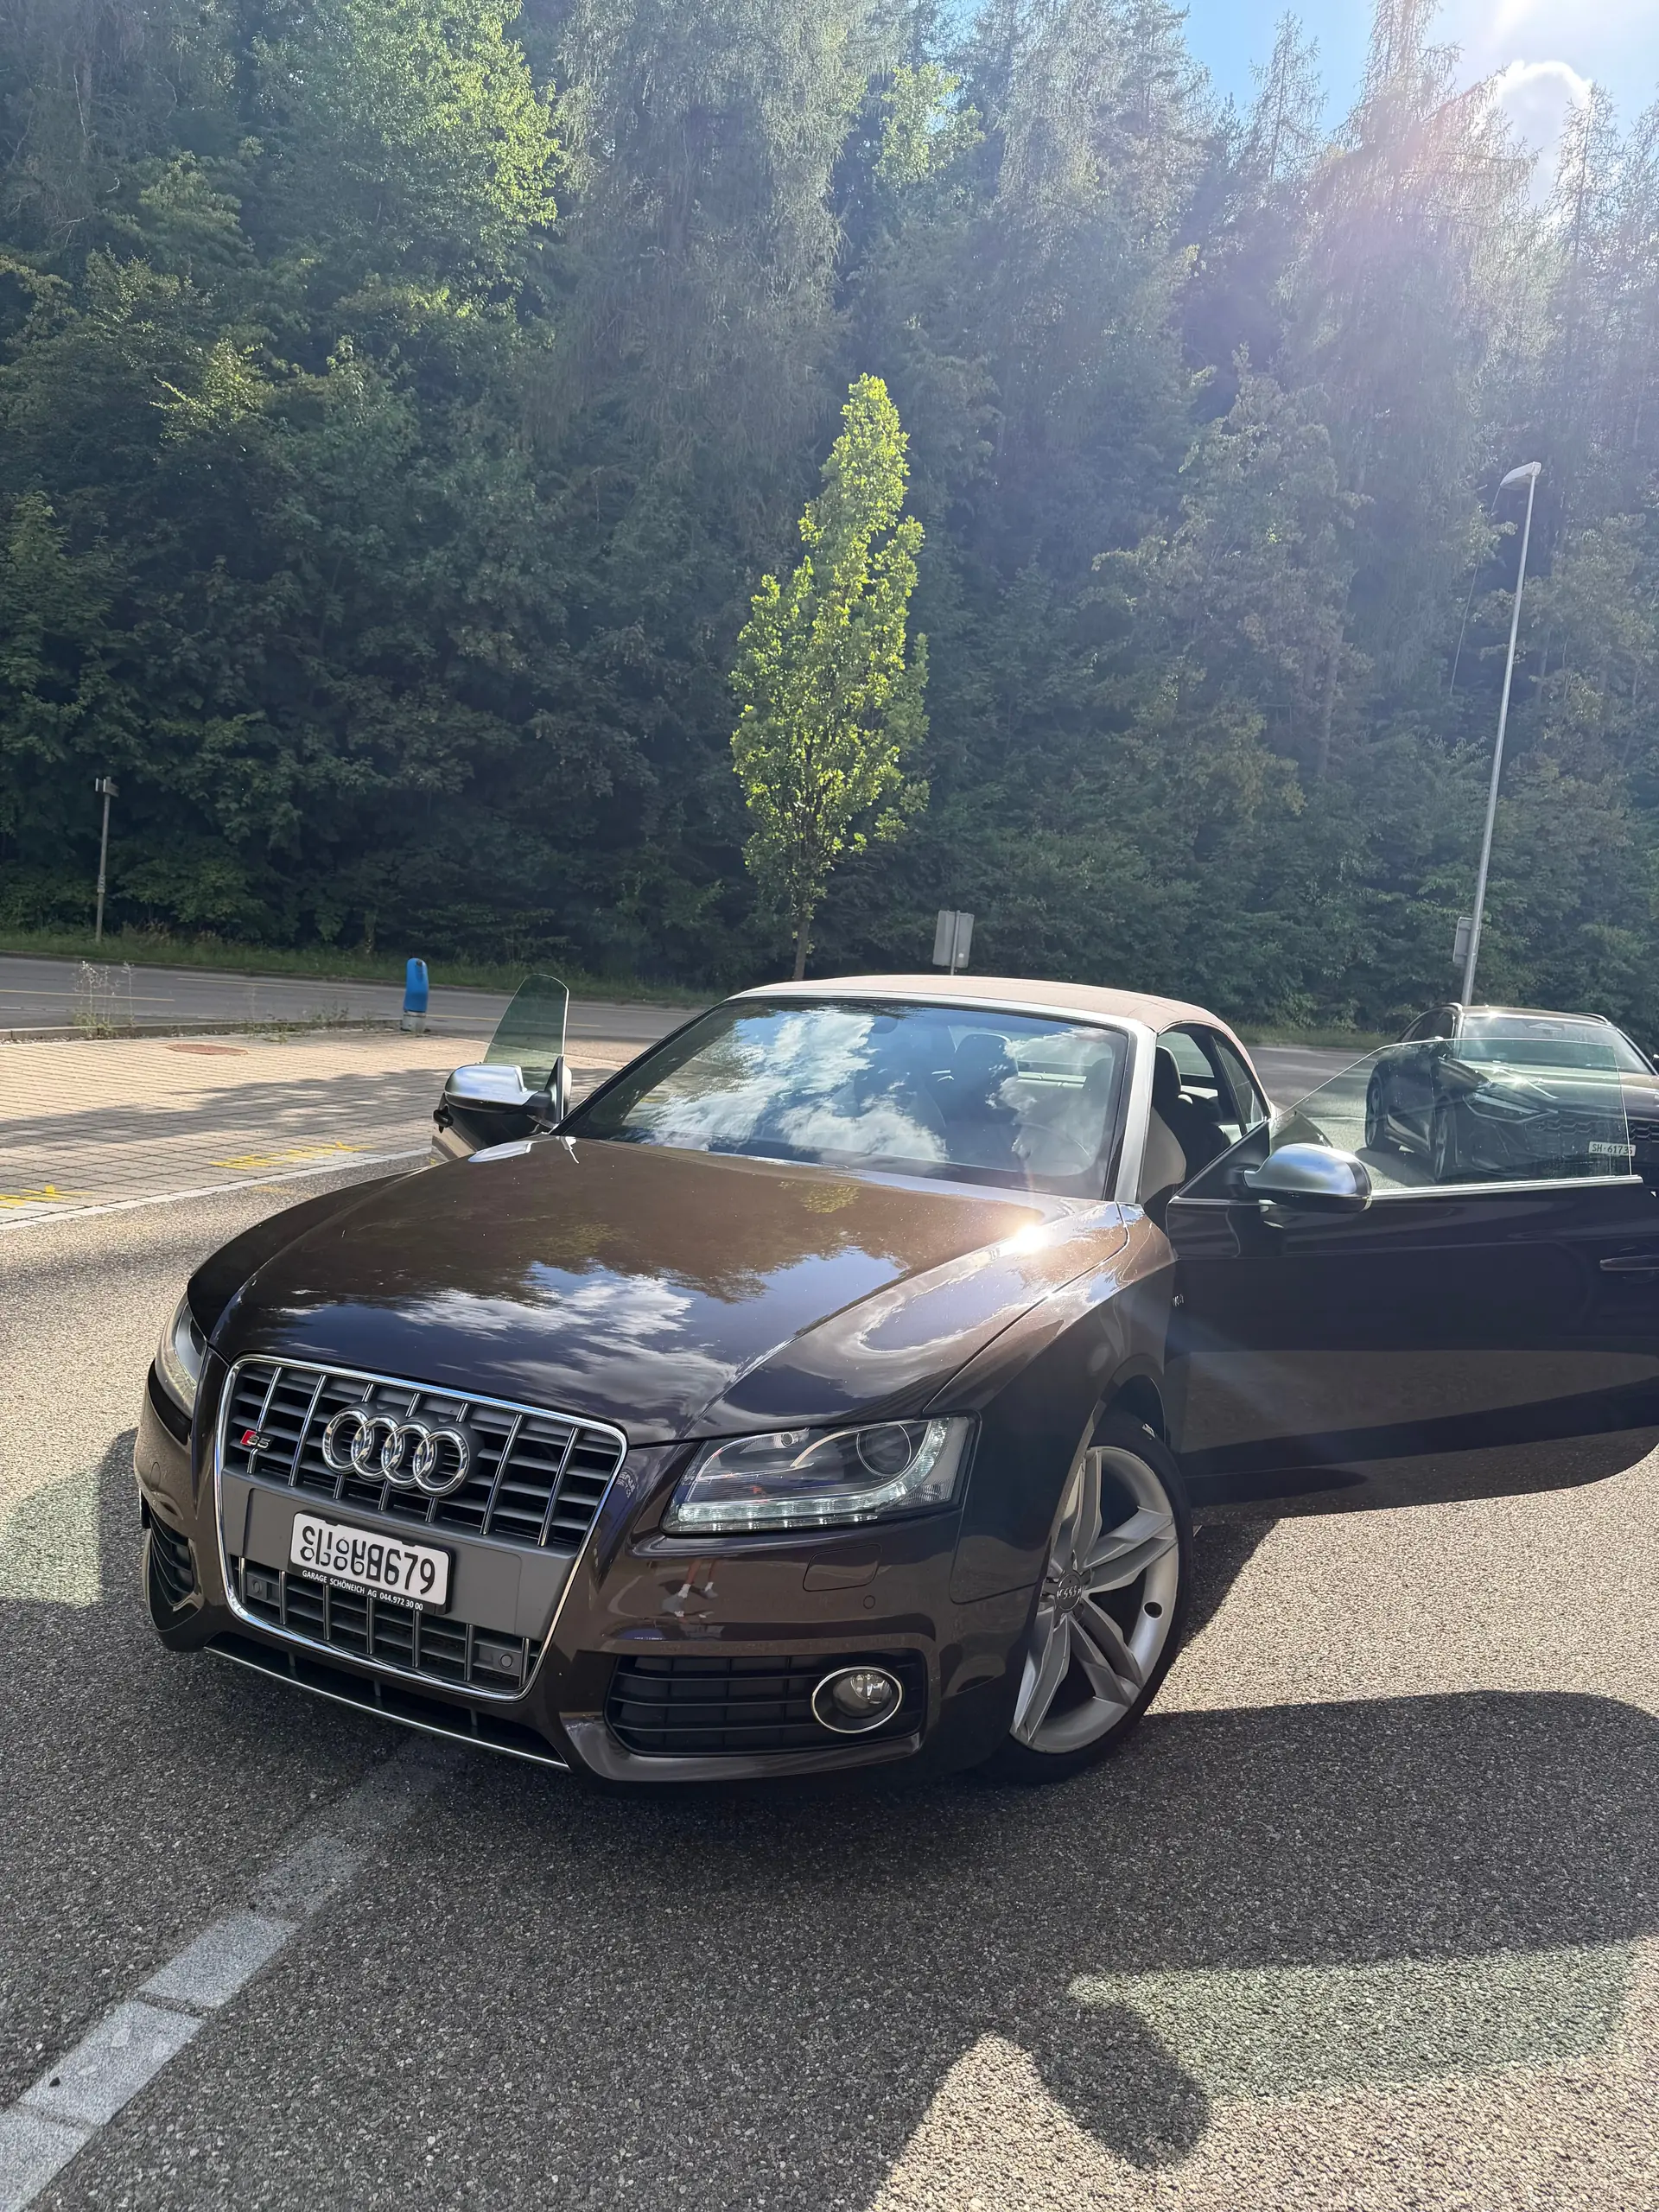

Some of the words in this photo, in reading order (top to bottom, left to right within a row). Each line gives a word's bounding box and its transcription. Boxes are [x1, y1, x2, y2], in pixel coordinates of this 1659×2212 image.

[246, 1434, 271, 1449] S5
[302, 1569, 328, 1584] GARAGE
[329, 1578, 365, 1594] SCHÖNEICH
[367, 1589, 378, 1598] AG
[379, 1592, 404, 1606] 044.972
[405, 1599, 414, 1608] 30
[415, 1602, 423, 1611] 00
